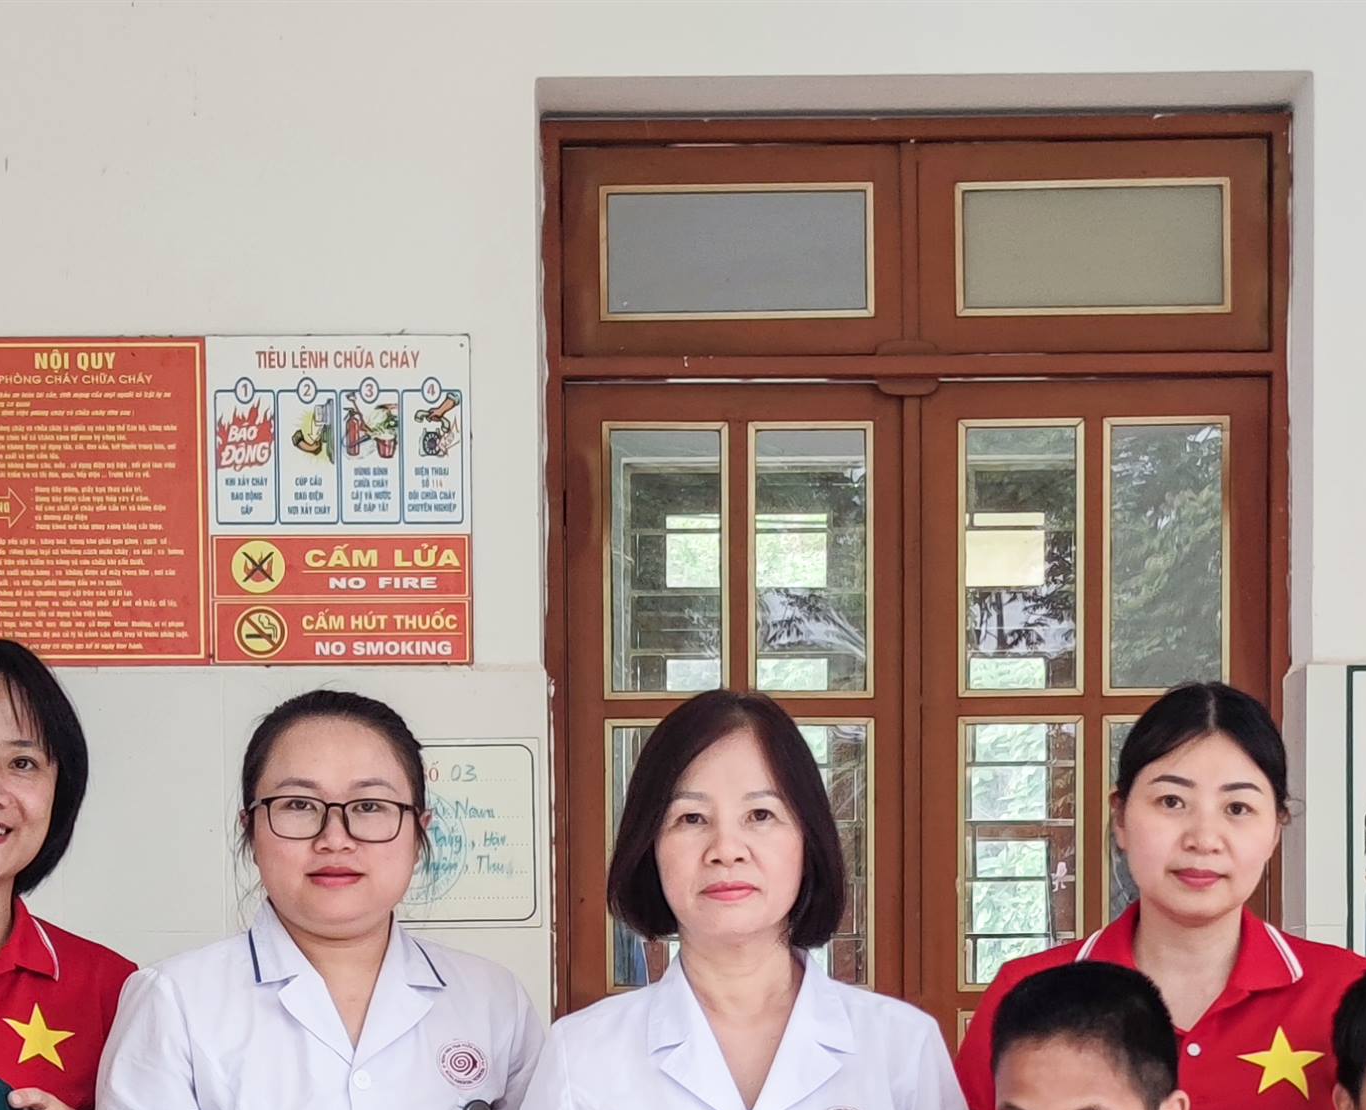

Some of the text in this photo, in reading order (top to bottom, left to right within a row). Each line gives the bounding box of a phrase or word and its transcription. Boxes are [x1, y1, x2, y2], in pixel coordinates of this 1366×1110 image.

[34, 349, 116, 373] NỘI QUY
[256, 344, 420, 374] TIÊU LỆNH CHỮA CHÁY
[45, 372, 78, 385] CHÁY
[82, 372, 115, 385] CHỮA
[118, 371, 153, 385] CHÁY
[241, 383, 249, 398] 1
[303, 383, 311, 398] 2
[365, 383, 374, 398] 3
[427, 383, 436, 397] 4
[228, 422, 258, 443] BÁO
[304, 541, 462, 568] CẤM LỬA
[328, 575, 438, 590] NO FIRE
[301, 610, 458, 631] CẤM HÚT THUỐC
[314, 640, 453, 656] NO SMOKING
[450, 764, 477, 782] 03
